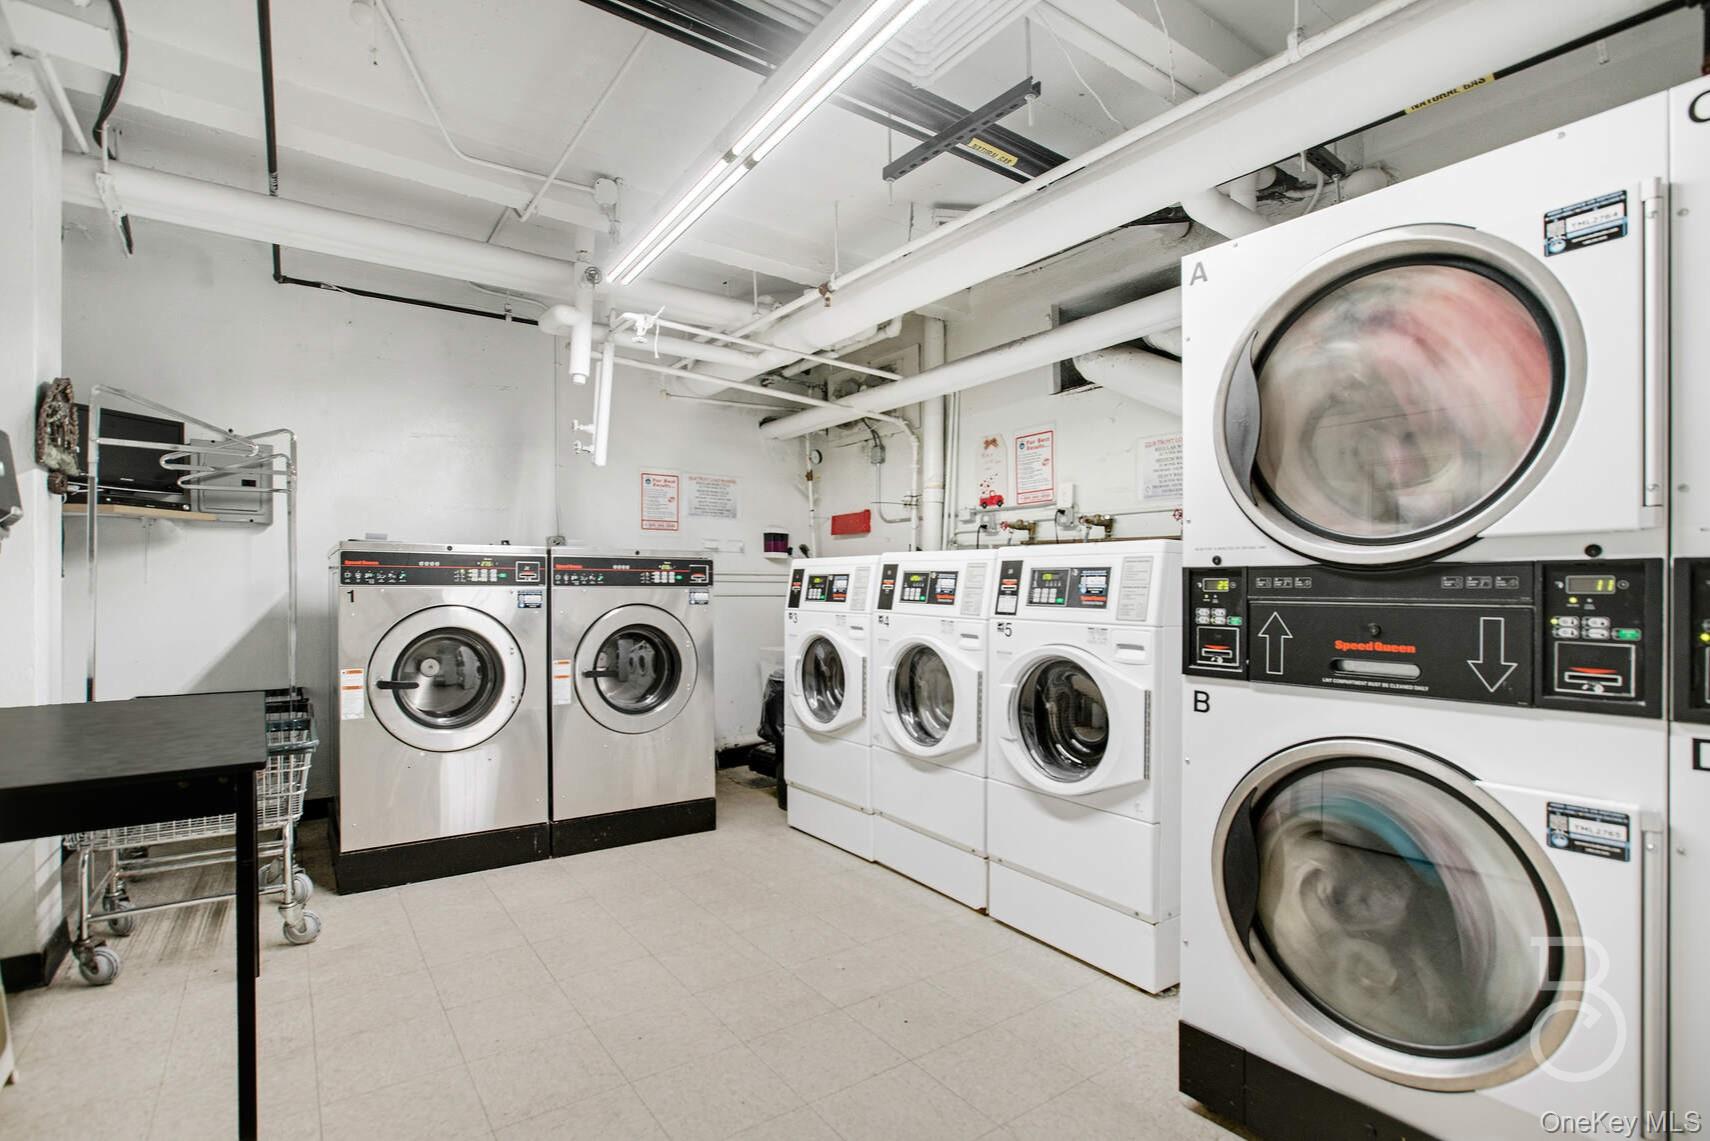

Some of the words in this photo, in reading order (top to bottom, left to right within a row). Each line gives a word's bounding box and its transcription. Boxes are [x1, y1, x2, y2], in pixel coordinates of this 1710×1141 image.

[1190, 261, 1208, 286] A
[346, 589, 355, 603] 1
[1334, 640, 1373, 651] Speed
[1374, 641, 1416, 653] Queen
[1194, 690, 1210, 713] B
